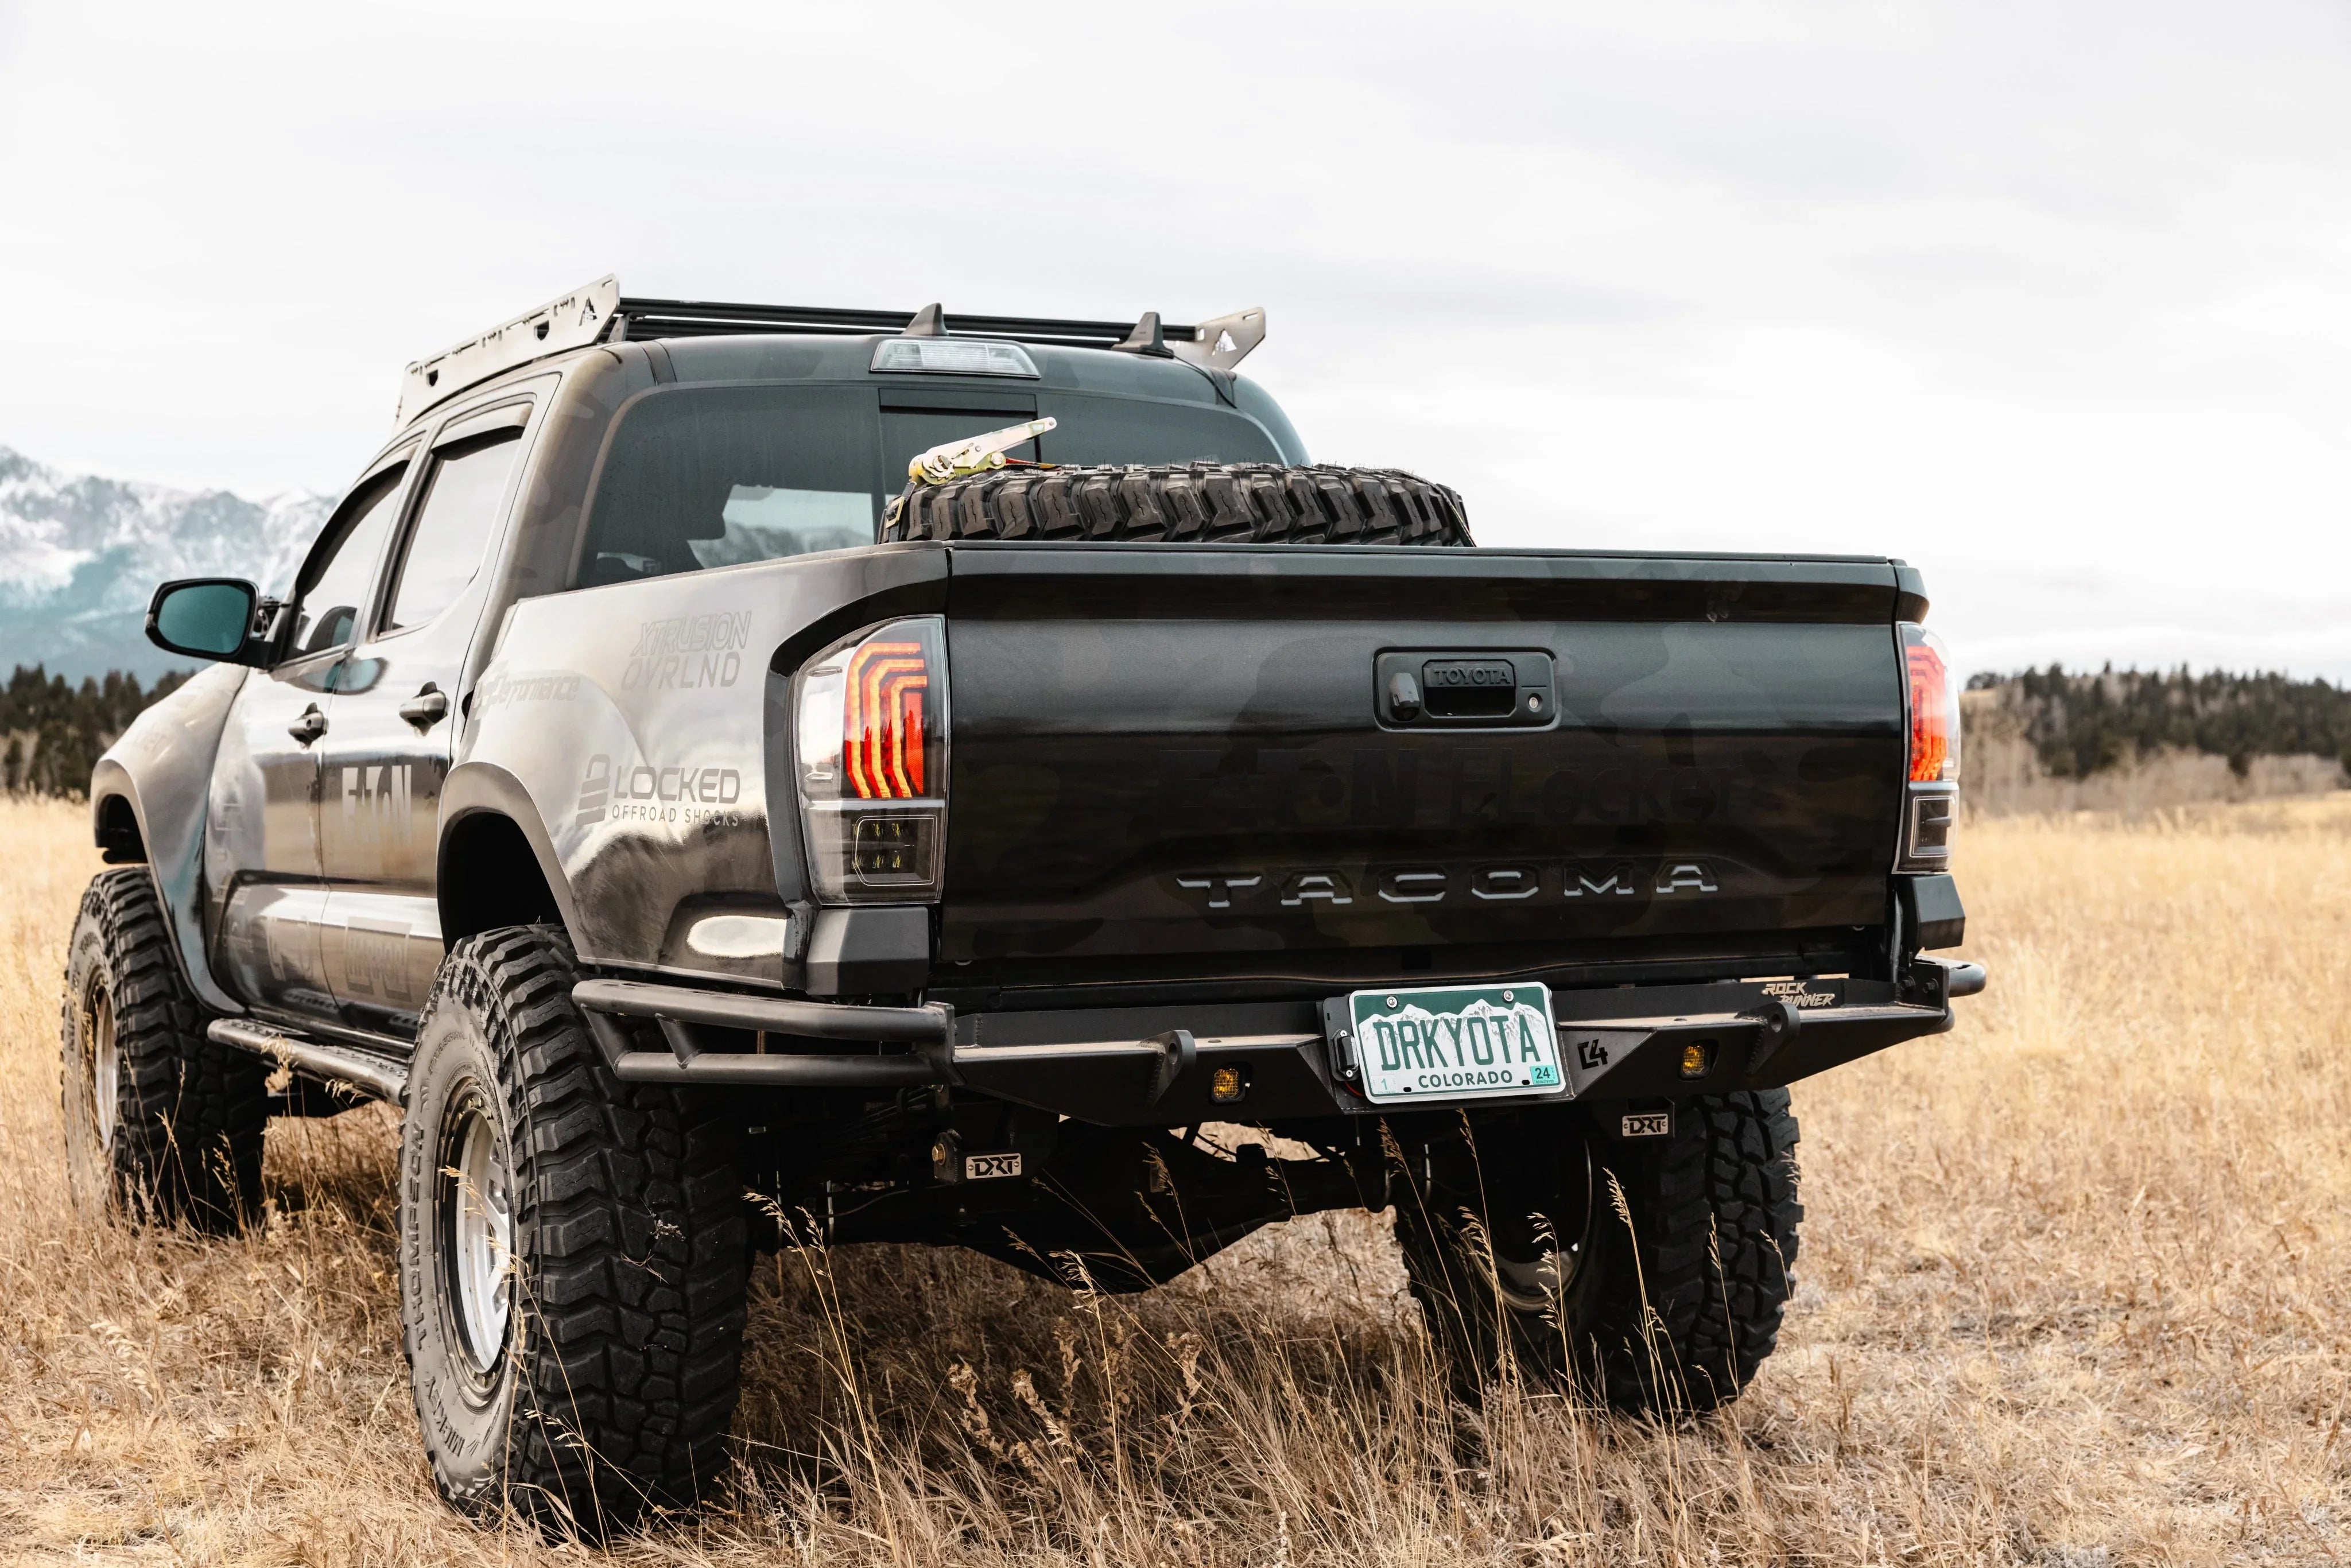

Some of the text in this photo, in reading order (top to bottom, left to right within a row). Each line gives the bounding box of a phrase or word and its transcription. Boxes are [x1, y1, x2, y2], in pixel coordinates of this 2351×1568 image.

[630, 610, 752, 657] XTRUSION
[622, 651, 740, 689] OVRLND
[1434, 667, 1511, 685] TOYOTA
[614, 765, 741, 805] LOCKED
[612, 805, 739, 827] OFFROAD SHOCKS
[1174, 859, 1720, 909] TACOMA
[1764, 982, 1807, 996] ROCK
[1780, 993, 1833, 1008] RUNNER
[1372, 1014, 1541, 1072] DRKYOTA
[1381, 1078, 1388, 1090] 1
[1418, 1070, 1513, 1089] COLORADO
[1535, 1067, 1551, 1079] 24
[1626, 1115, 1667, 1135] DRT
[971, 1155, 1019, 1177] DRT
[408, 1120, 427, 1350] THOMPSON
